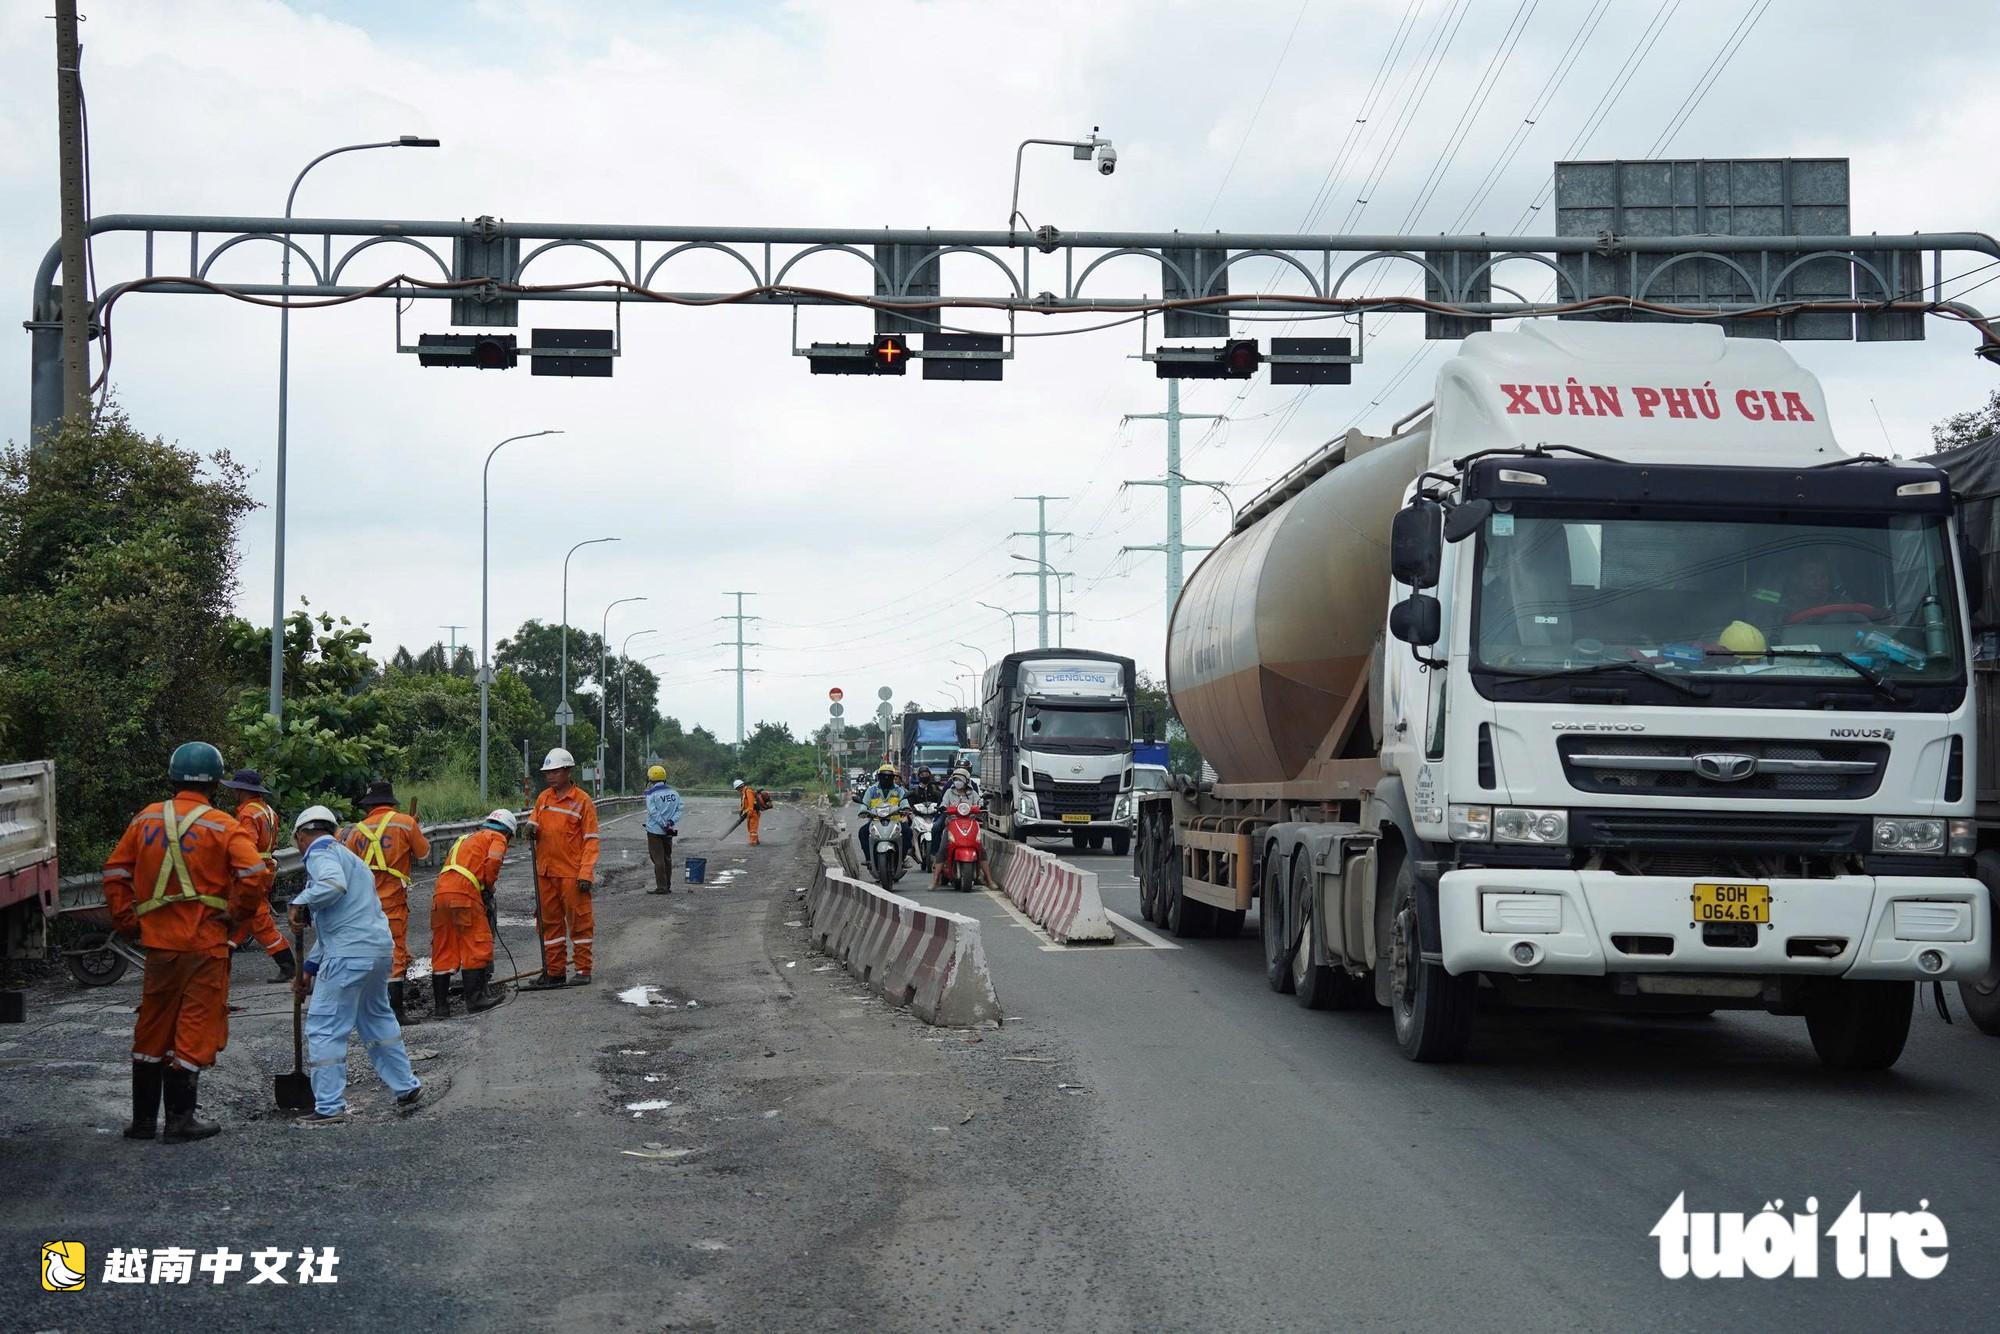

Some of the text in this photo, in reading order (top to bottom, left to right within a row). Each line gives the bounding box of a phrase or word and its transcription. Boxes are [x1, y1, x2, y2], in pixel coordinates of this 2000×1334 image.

[1500, 377, 1815, 421] XUÂN PHÚ GIA
[1045, 674, 1106, 684] CHENGLONG
[1551, 721, 1646, 732] DAEWOO
[1830, 728, 1882, 738] NOVUS
[660, 793, 676, 803] VEC
[143, 824, 198, 853] VC
[1716, 886, 1748, 902] 60H
[1703, 904, 1759, 920] 064.61
